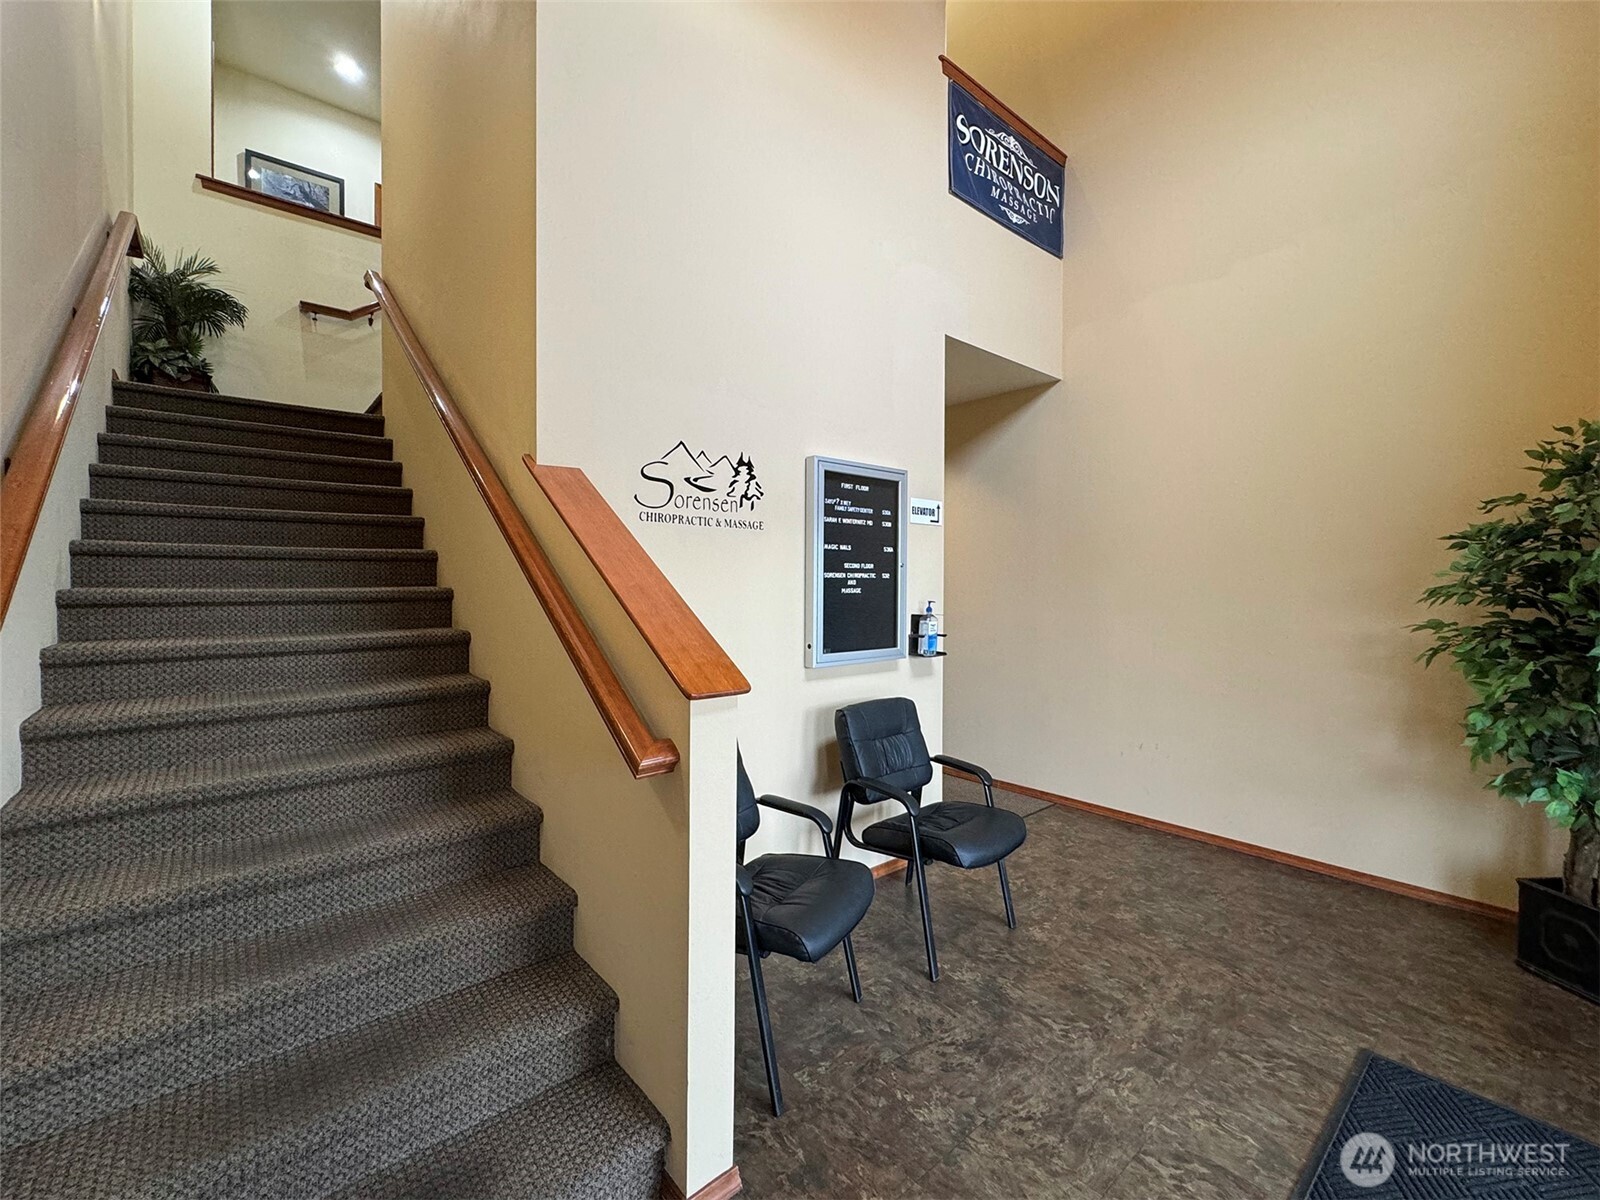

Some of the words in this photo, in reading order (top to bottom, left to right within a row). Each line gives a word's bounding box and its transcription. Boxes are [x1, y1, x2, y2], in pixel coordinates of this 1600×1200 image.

[956, 114, 1060, 208] SORENSON
[990, 186, 1038, 223] MASSAGE
[634, 460, 738, 513] Sorensen
[639, 511, 714, 528] CHIROPRACTIC
[715, 518, 722, 528] &
[724, 519, 765, 531] MASSAGE
[912, 506, 934, 516] ELEVATOR
